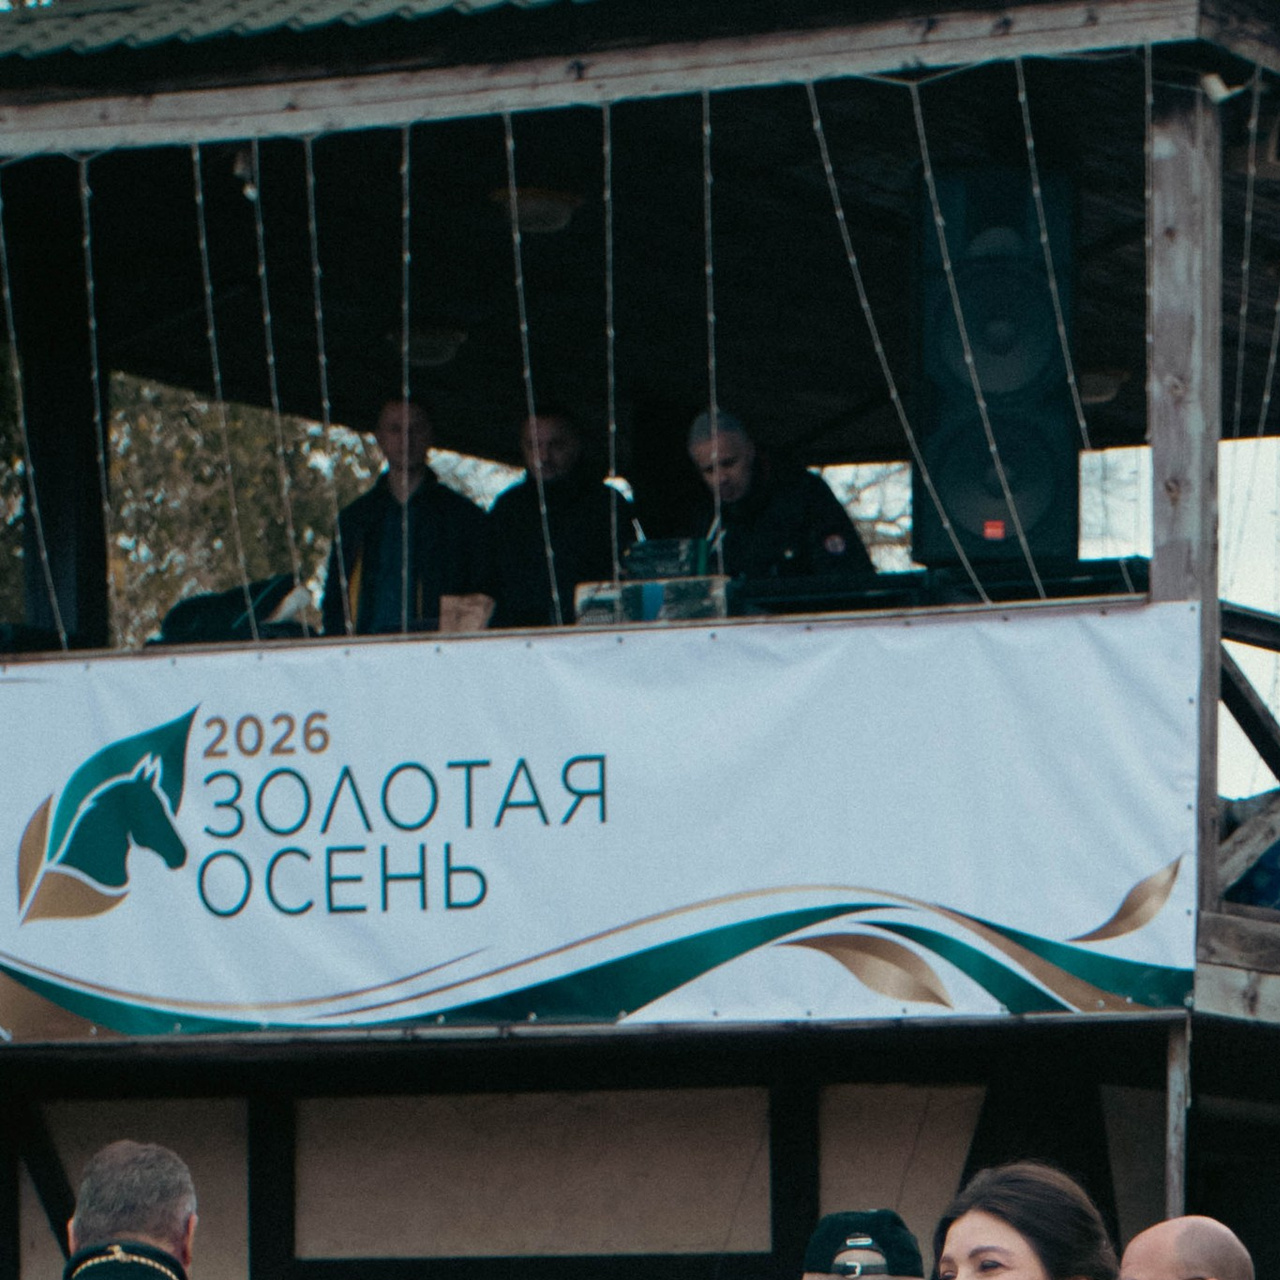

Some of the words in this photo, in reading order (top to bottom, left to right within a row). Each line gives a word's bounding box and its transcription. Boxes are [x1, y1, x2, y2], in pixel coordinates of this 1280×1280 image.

[203, 711, 330, 759] 2026
[203, 754, 607, 839] ЗОЛОТАЯ
[197, 843, 488, 918] ОСЕНЬ
